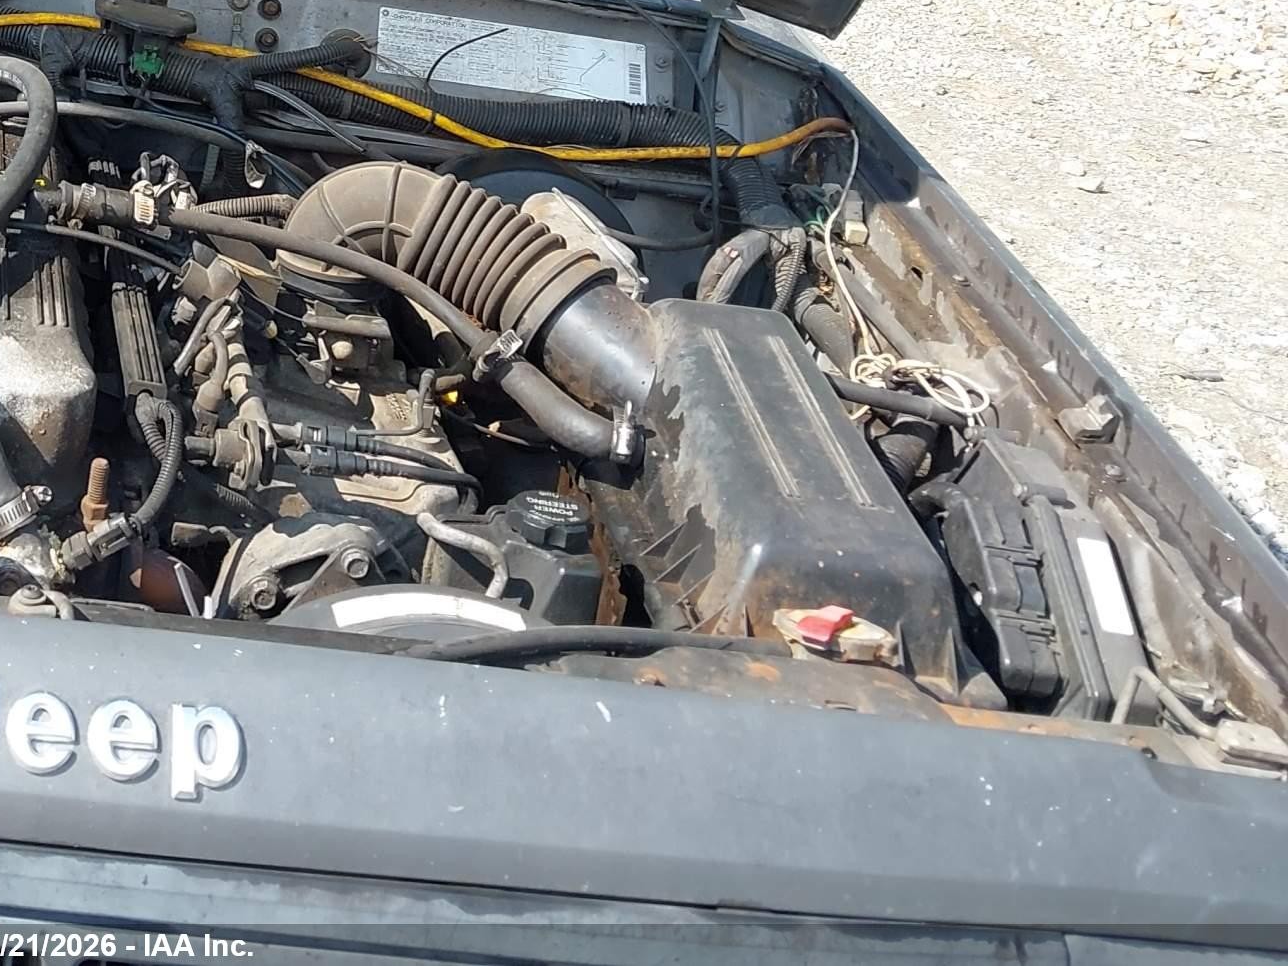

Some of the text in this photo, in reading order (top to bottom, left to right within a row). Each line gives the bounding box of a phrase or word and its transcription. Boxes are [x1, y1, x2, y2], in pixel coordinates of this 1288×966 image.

[425, 18, 467, 28] CORPORATION
[525, 497, 579, 510] STEERING
[533, 504, 574, 516] POWER
